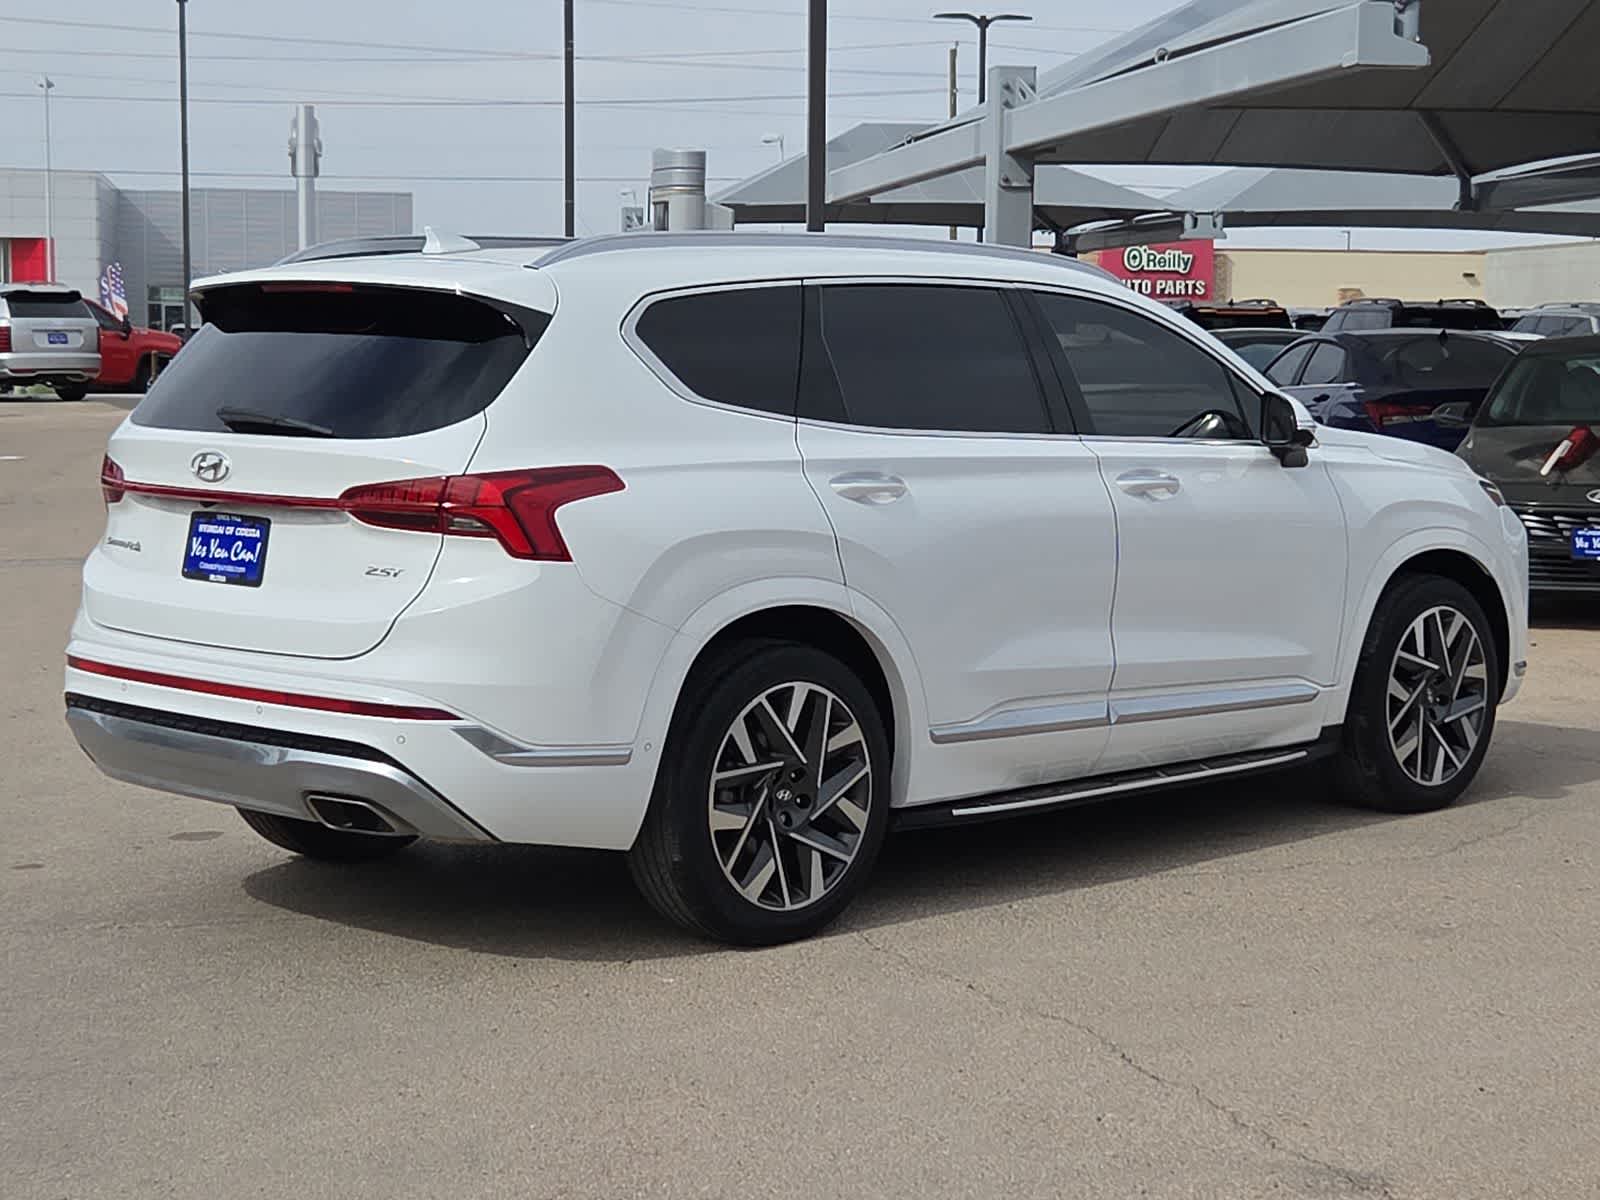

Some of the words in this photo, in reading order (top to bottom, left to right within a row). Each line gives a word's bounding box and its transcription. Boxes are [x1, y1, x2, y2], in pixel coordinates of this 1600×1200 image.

[1124, 246, 1193, 274] O'Reilly
[1121, 279, 1152, 295] UTO
[1156, 279, 1206, 295] PARTS
[190, 536, 207, 558] Yes
[208, 538, 229, 559] You
[230, 540, 262, 563] Can!
